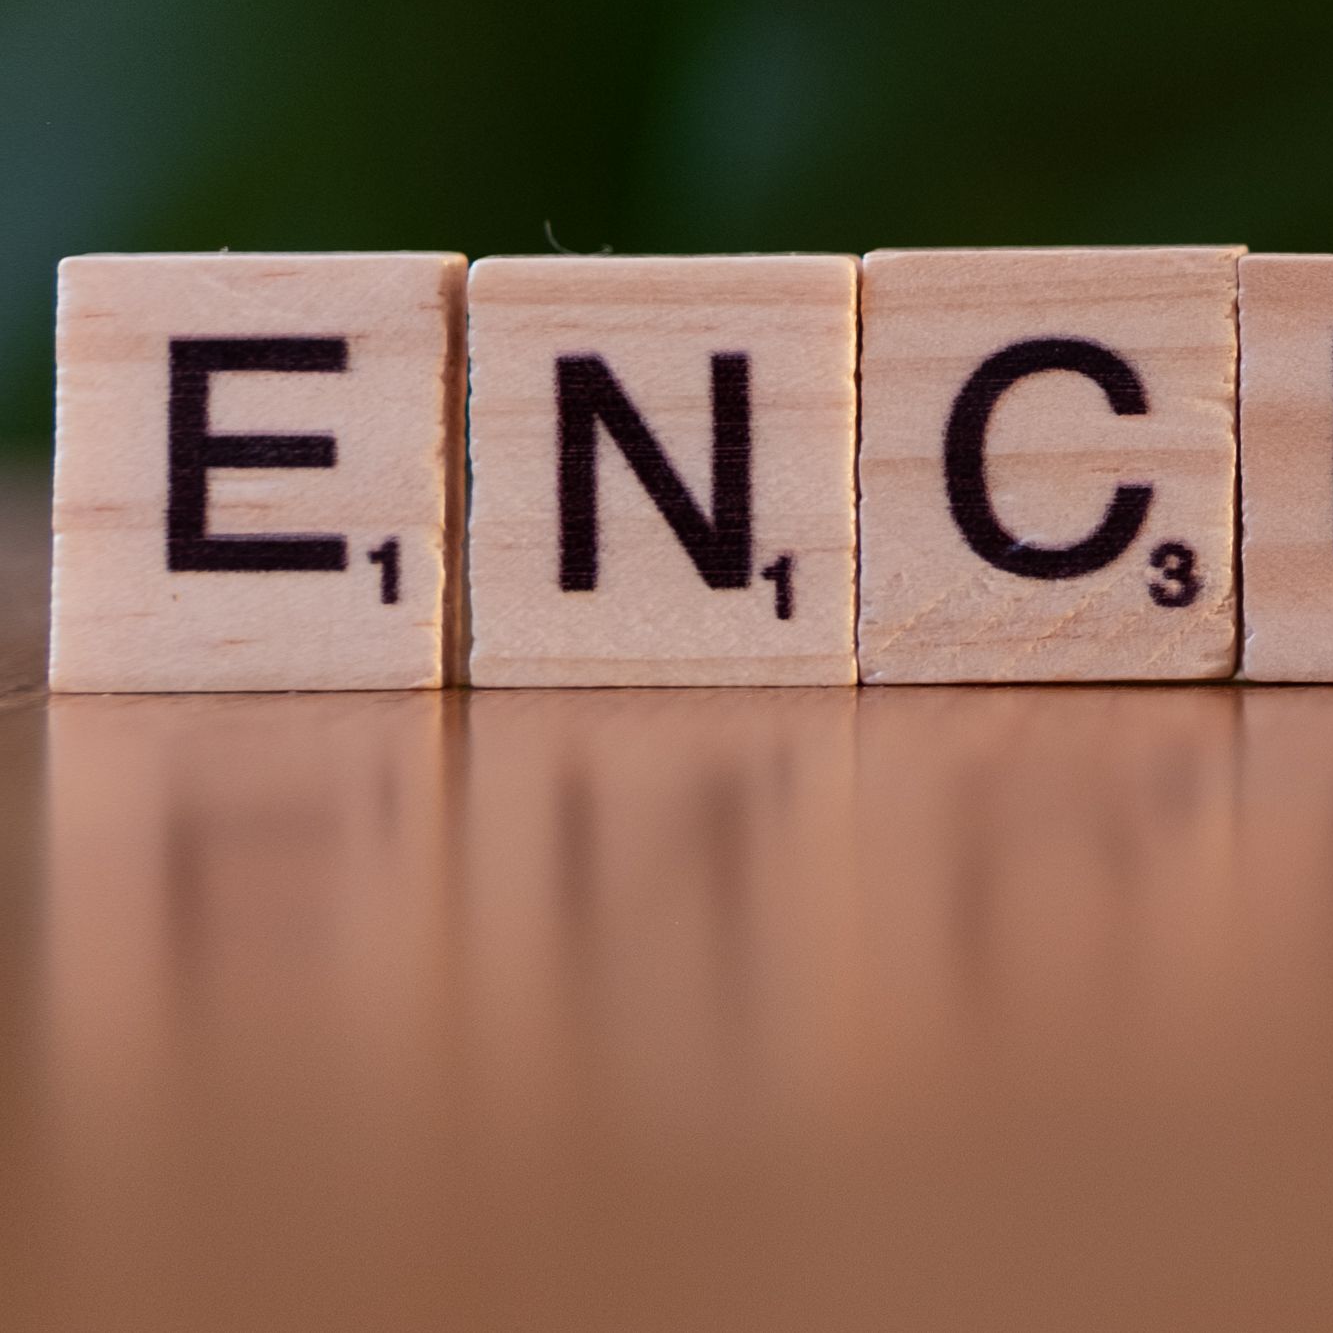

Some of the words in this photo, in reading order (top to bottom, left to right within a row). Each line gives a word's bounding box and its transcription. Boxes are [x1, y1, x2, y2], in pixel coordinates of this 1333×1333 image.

[365, 535, 403, 607] 1
[757, 552, 796, 623] 1
[1146, 538, 1207, 611] 3
